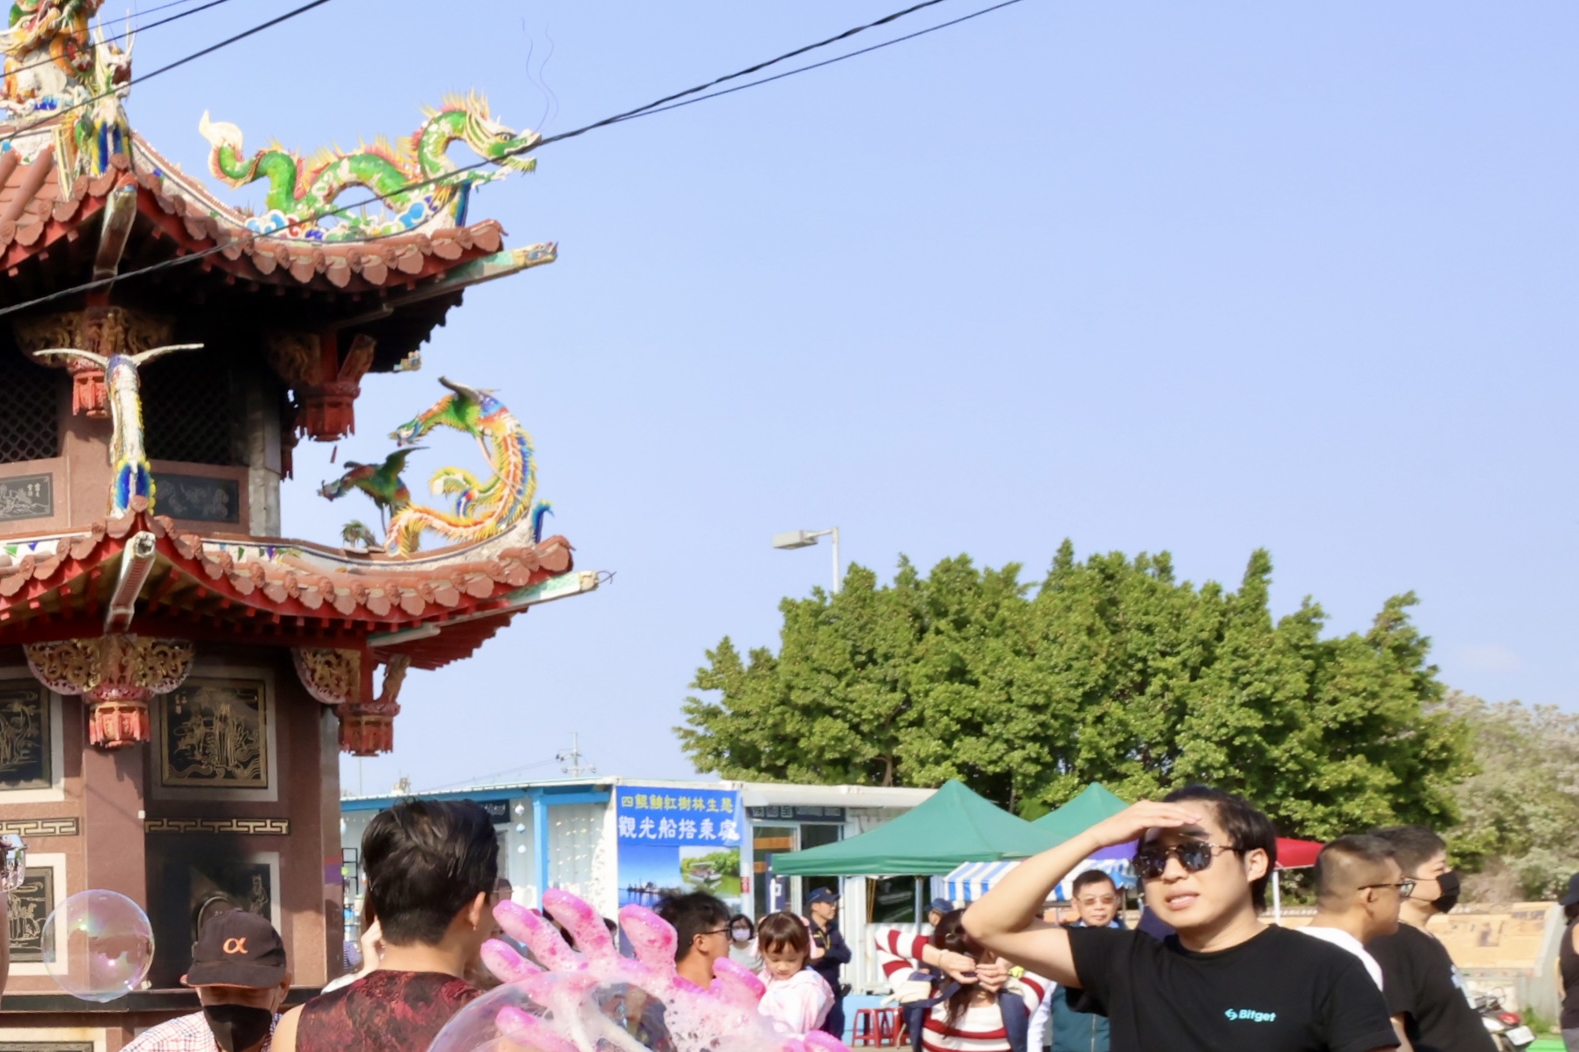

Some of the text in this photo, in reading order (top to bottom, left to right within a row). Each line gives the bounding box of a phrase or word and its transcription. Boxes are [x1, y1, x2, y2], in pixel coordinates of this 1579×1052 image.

[618, 815, 741, 841] 觀光船搭乘處
[1238, 1008, 1277, 1022] Bitget
